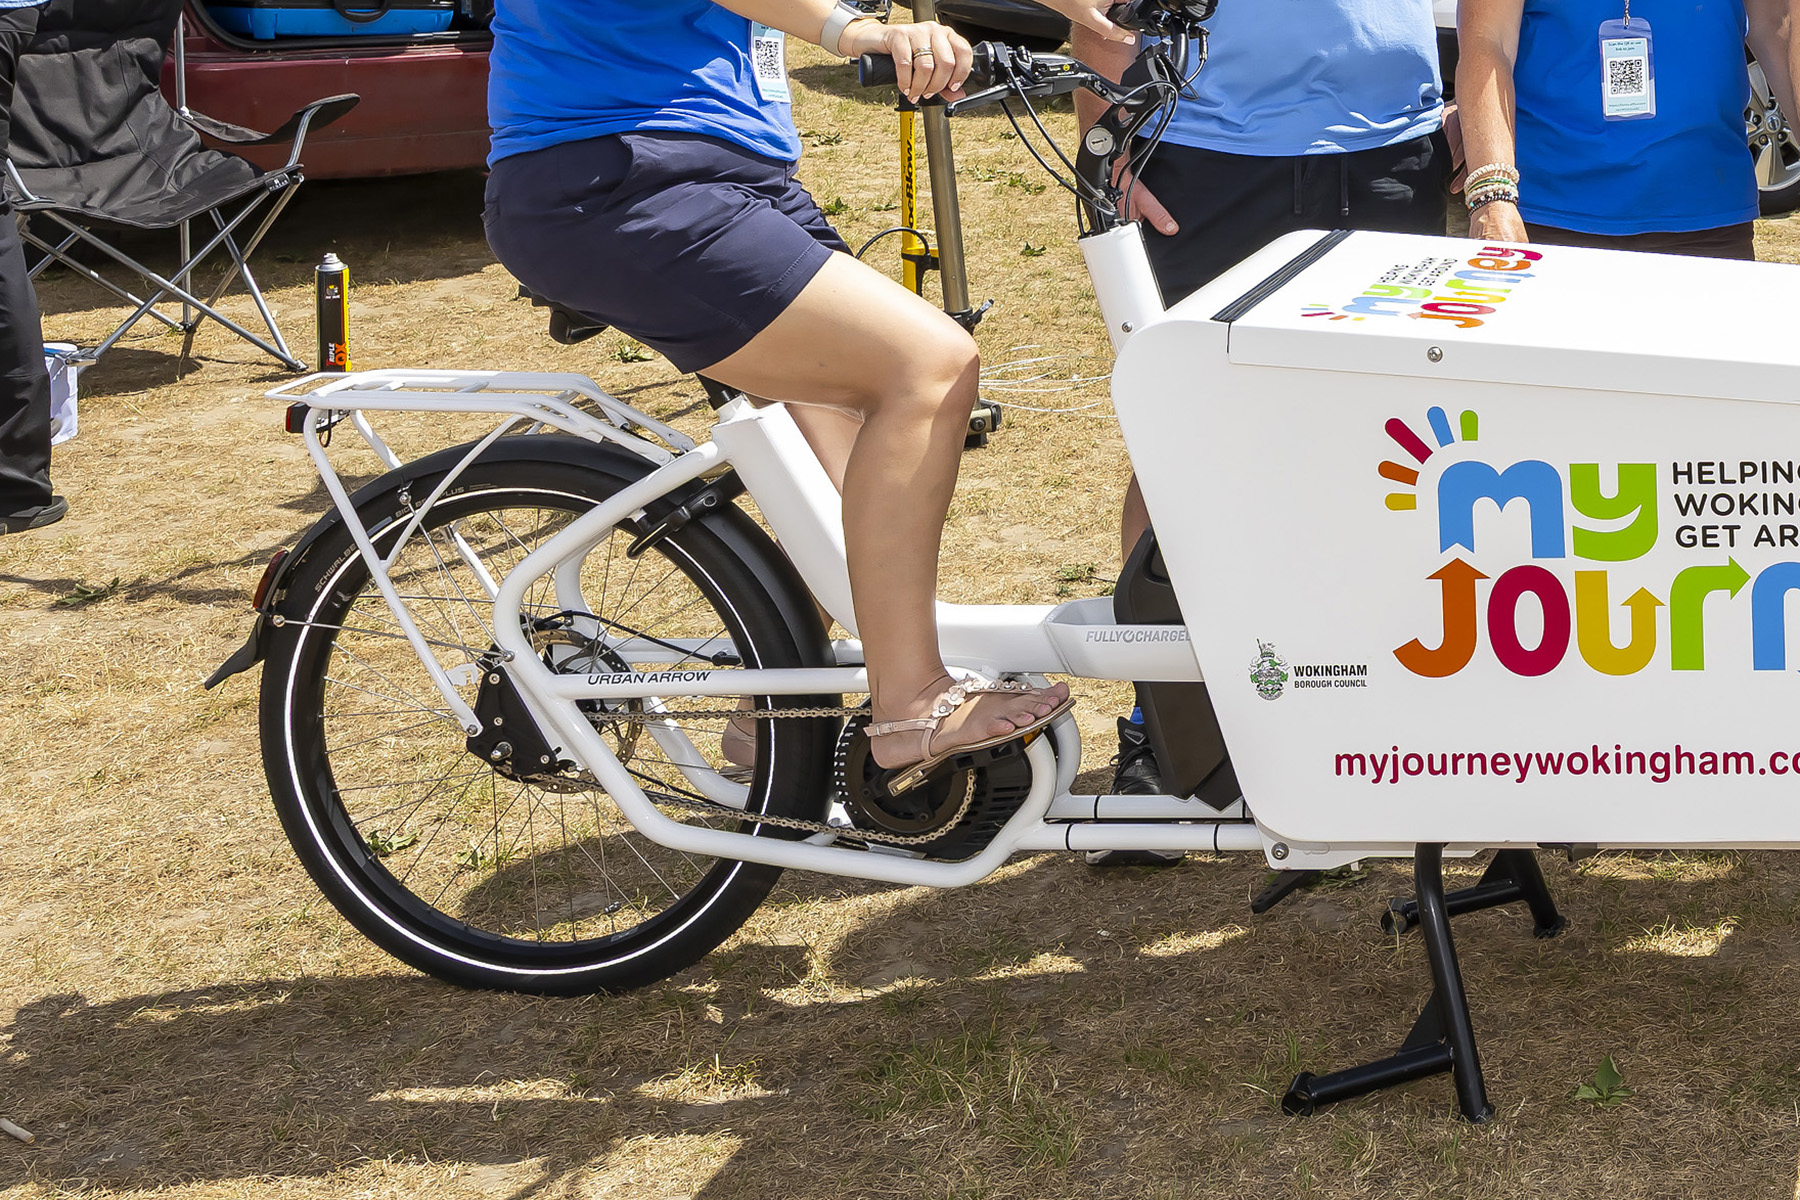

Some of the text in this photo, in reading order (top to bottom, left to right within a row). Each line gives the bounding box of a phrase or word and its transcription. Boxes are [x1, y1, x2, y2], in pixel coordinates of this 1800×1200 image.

[1437, 457, 1659, 561] my
[1674, 524, 1742, 549] GET
[1294, 664, 1367, 677] WOKINGHAM
[587, 671, 711, 686] URBAN ARROW
[1294, 679, 1367, 689] BOROUGH COUNCIL
